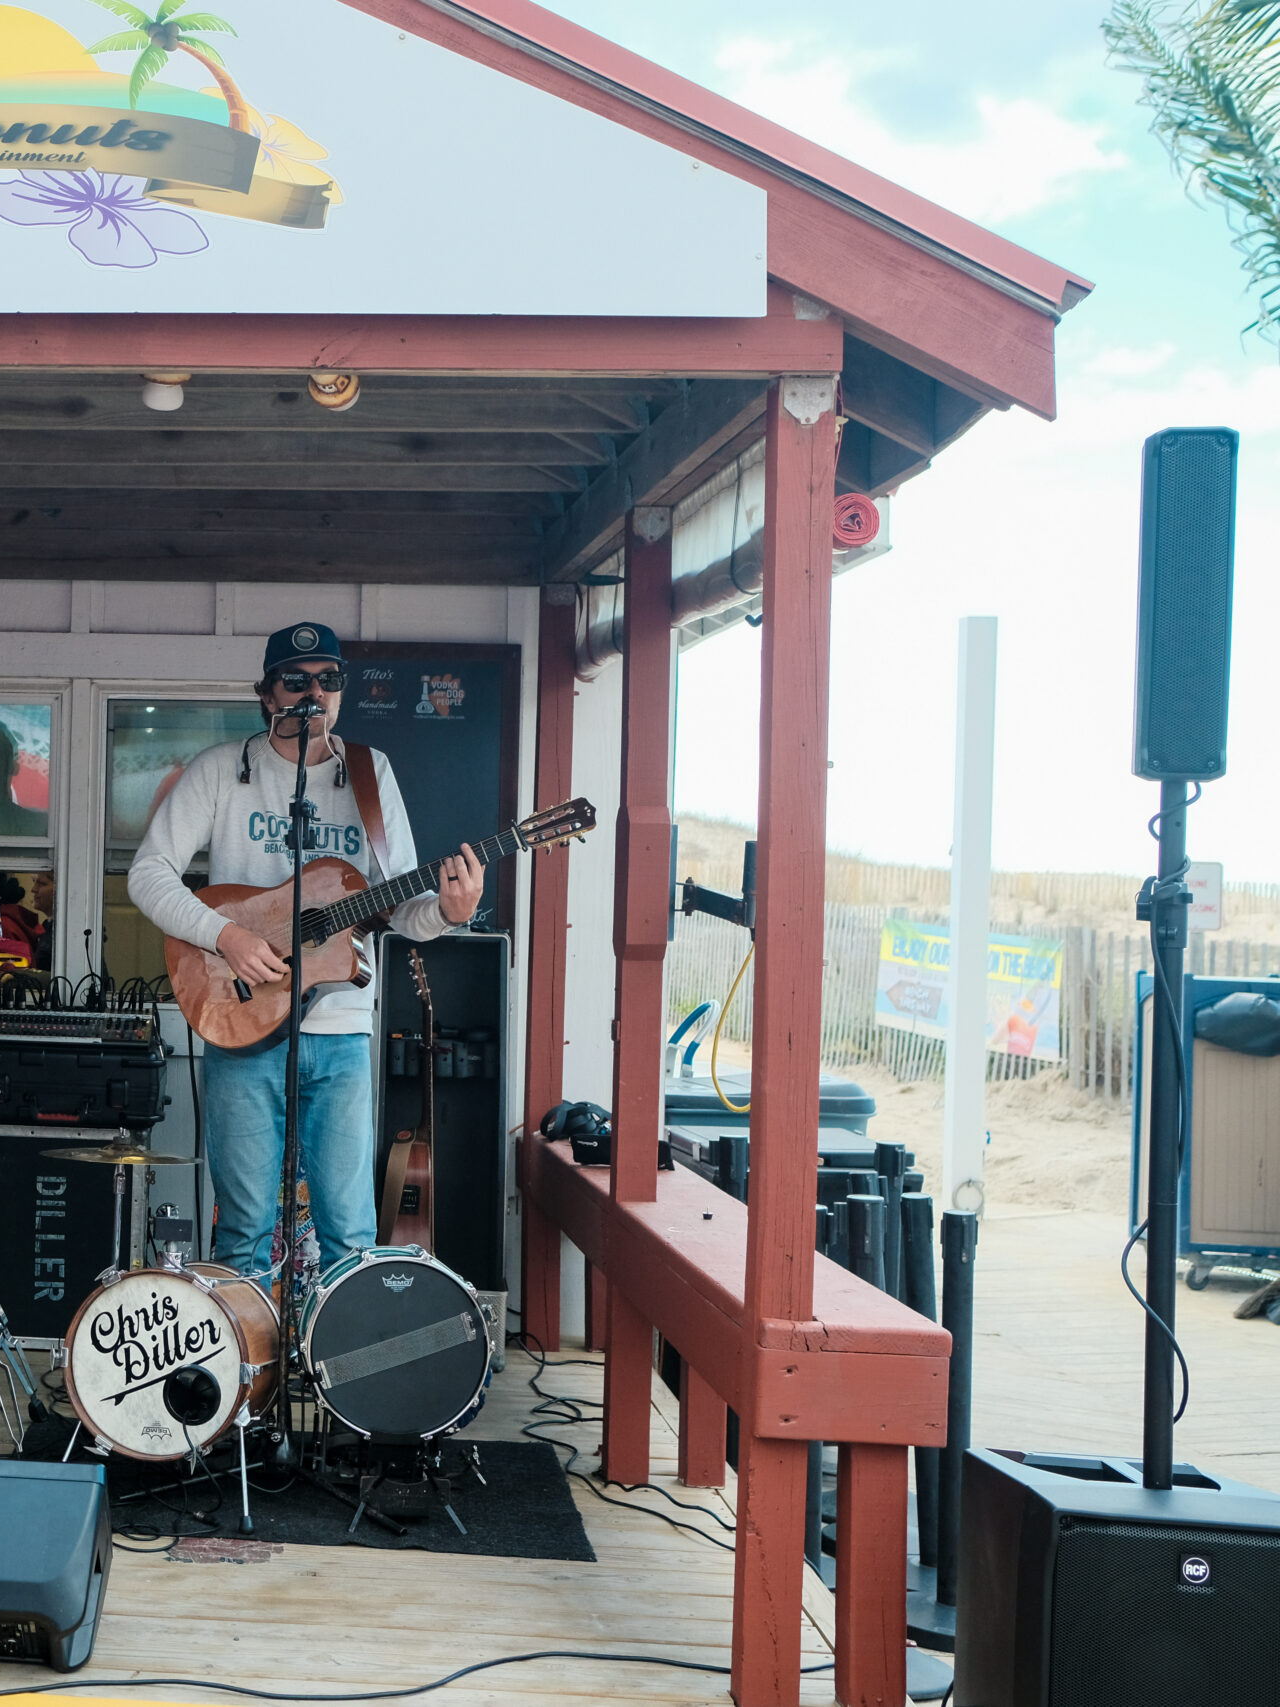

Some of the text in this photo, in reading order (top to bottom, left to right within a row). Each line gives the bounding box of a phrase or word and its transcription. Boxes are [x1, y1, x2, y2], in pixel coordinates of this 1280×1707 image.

[362, 668, 394, 680] Tito's
[431, 681, 458, 689] VODKA
[446, 689, 465, 699] DOG
[357, 699, 398, 709] Handmade
[436, 698, 463, 706] PEOPLE
[249, 812, 360, 855] COCUTS
[265, 843, 288, 855] BEAC
[1003, 952, 1023, 977] THE
[34, 1175, 68, 1302] DILLER
[90, 1291, 179, 1354] Chris
[112, 1318, 221, 1385] Diller
[1185, 1564, 1206, 1576] RCF
